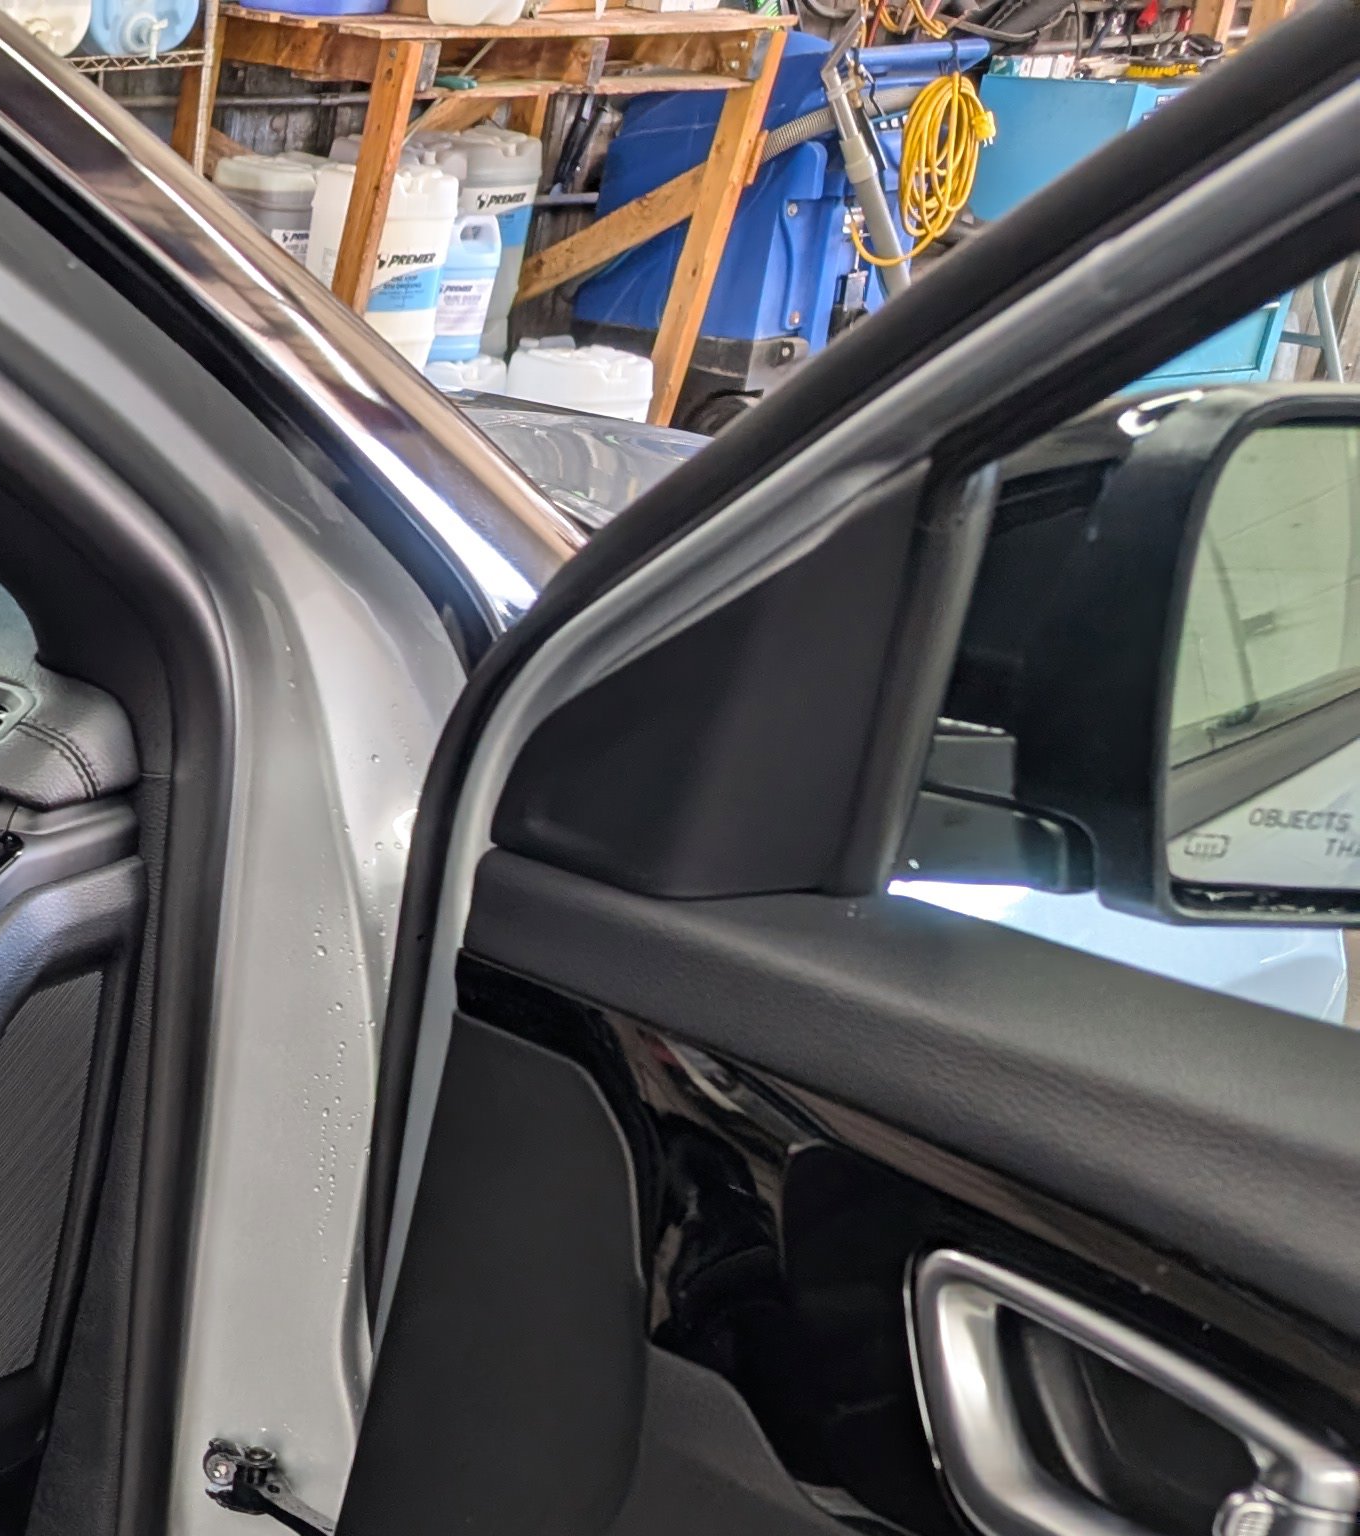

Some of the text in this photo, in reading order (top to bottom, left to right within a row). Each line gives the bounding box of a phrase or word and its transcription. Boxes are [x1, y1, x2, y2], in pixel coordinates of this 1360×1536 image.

[486, 192, 527, 208] PREMIER
[387, 253, 436, 268] PREMIER
[1248, 808, 1353, 832] OBJECTS
